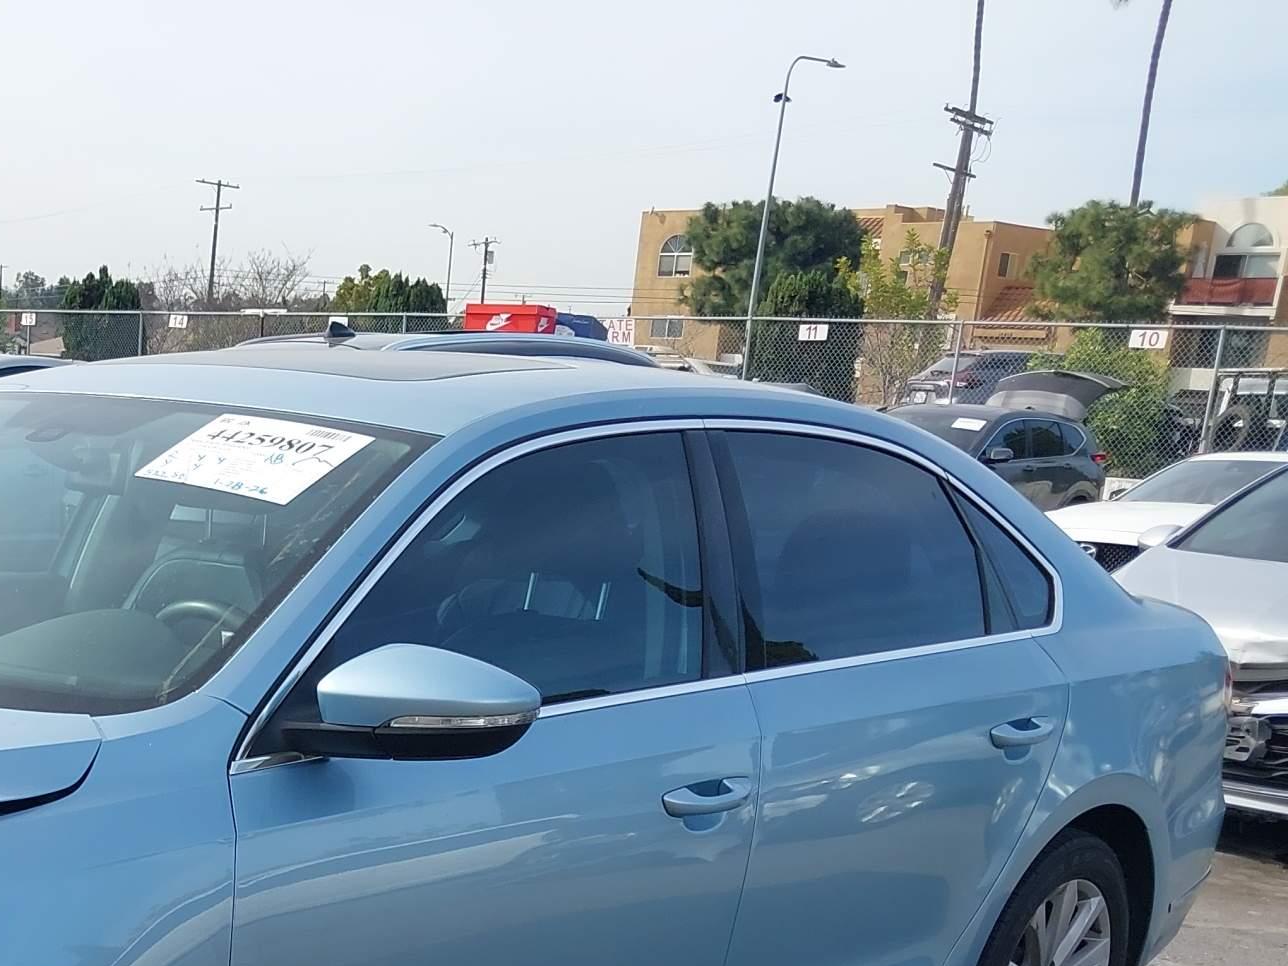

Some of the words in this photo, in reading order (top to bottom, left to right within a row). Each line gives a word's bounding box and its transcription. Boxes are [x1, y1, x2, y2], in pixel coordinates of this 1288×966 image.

[174, 316, 184, 327] 14
[599, 320, 633, 331] TATE
[611, 331, 631, 343] RM
[806, 325, 818, 340] 11
[1138, 331, 1160, 347] 10
[207, 428, 335, 458] 44259807
